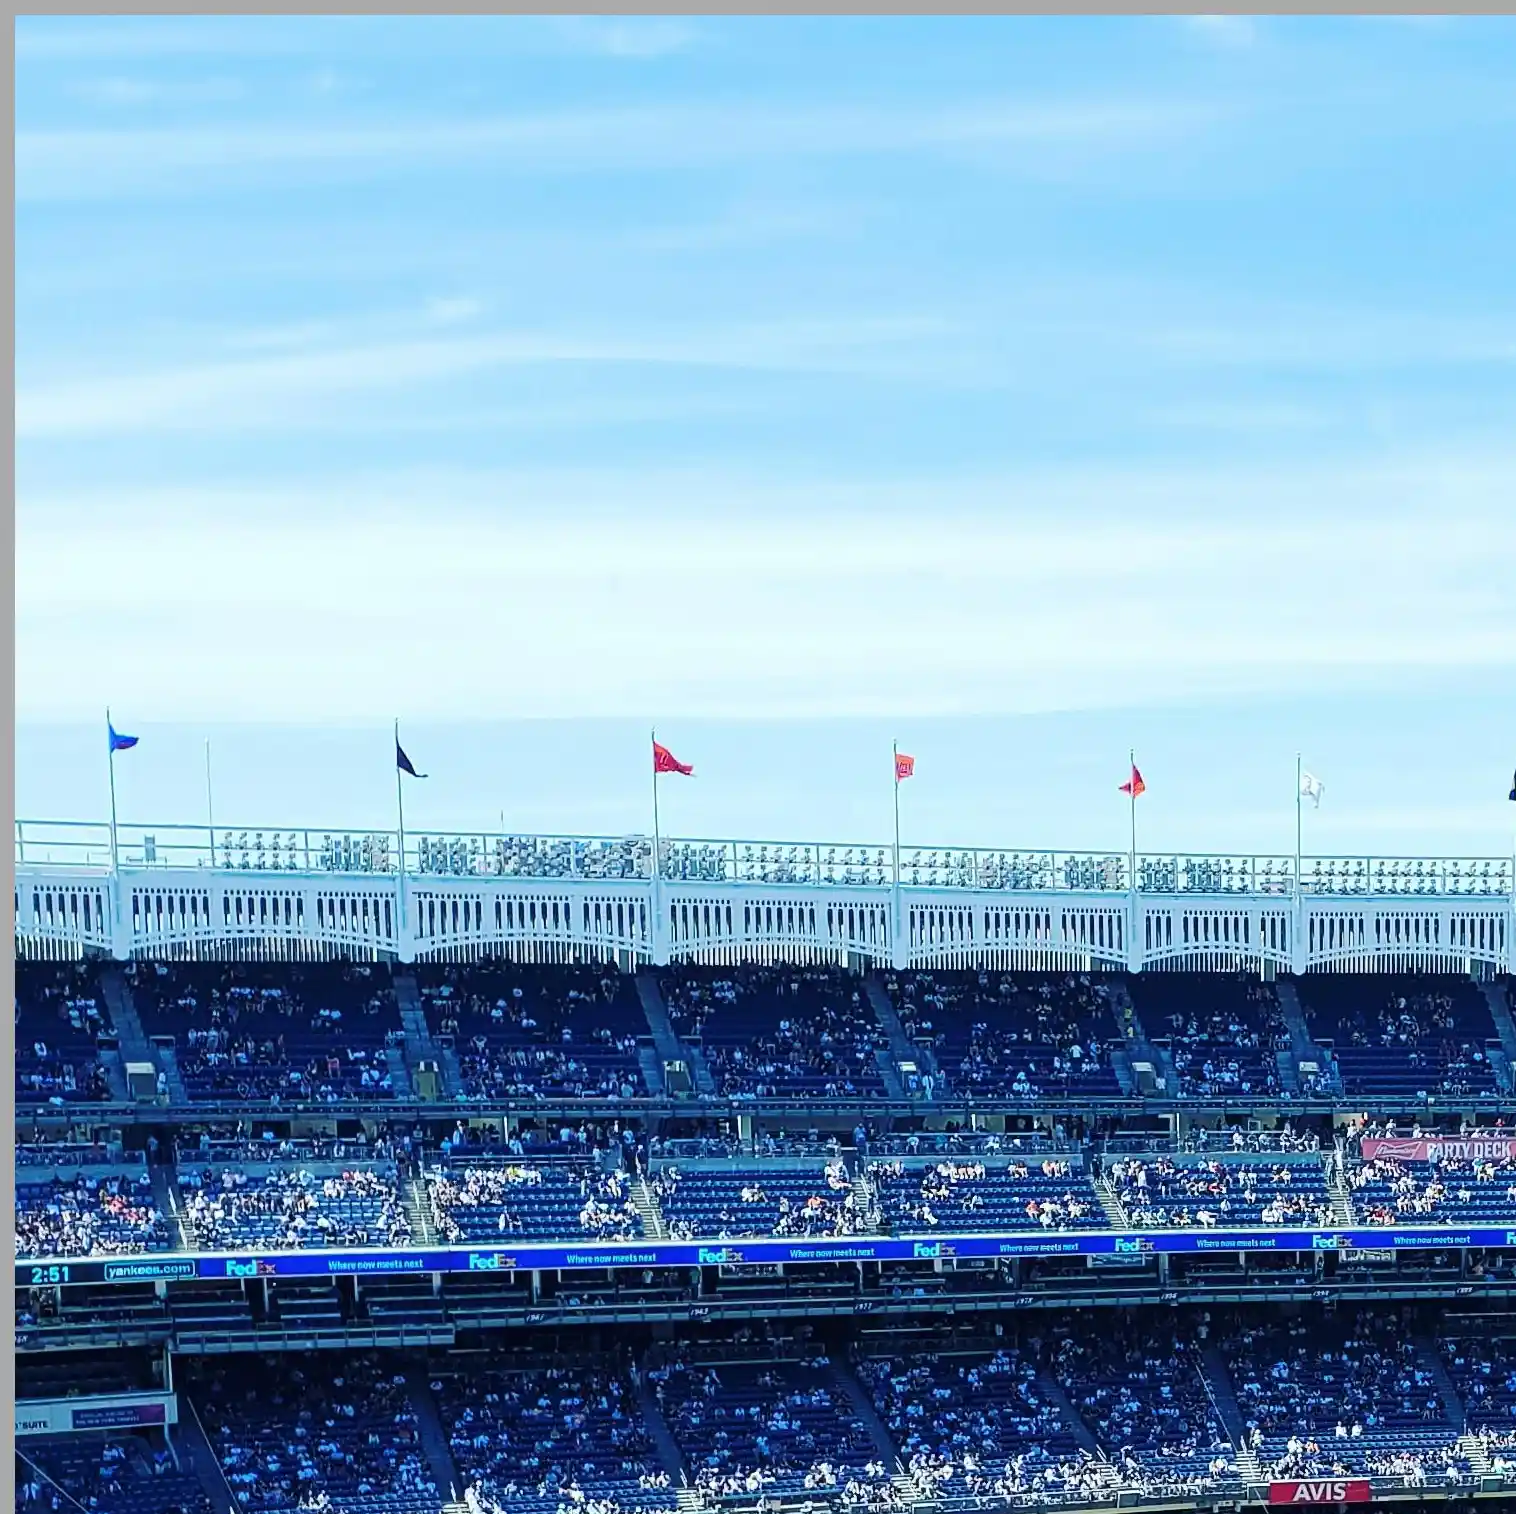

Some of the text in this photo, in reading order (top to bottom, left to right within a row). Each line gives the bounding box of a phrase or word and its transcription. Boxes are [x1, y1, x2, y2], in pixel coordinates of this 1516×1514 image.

[1427, 1142, 1474, 1159] PARTY
[1477, 1141, 1512, 1158] DECK
[1115, 1238, 1154, 1252] FedEx
[1312, 1234, 1353, 1248] FedEx
[566, 1252, 657, 1265] Where now meets next
[698, 1248, 743, 1264] FedEx
[913, 1243, 956, 1258] FedEx
[226, 1260, 276, 1276] FedEx
[327, 1260, 357, 1271] Where
[403, 1258, 424, 1269] next
[469, 1252, 517, 1270] FedEx
[32, 1265, 70, 1284] 2:51
[108, 1263, 192, 1279] yankees.com
[1292, 1482, 1347, 1502] AVIS
